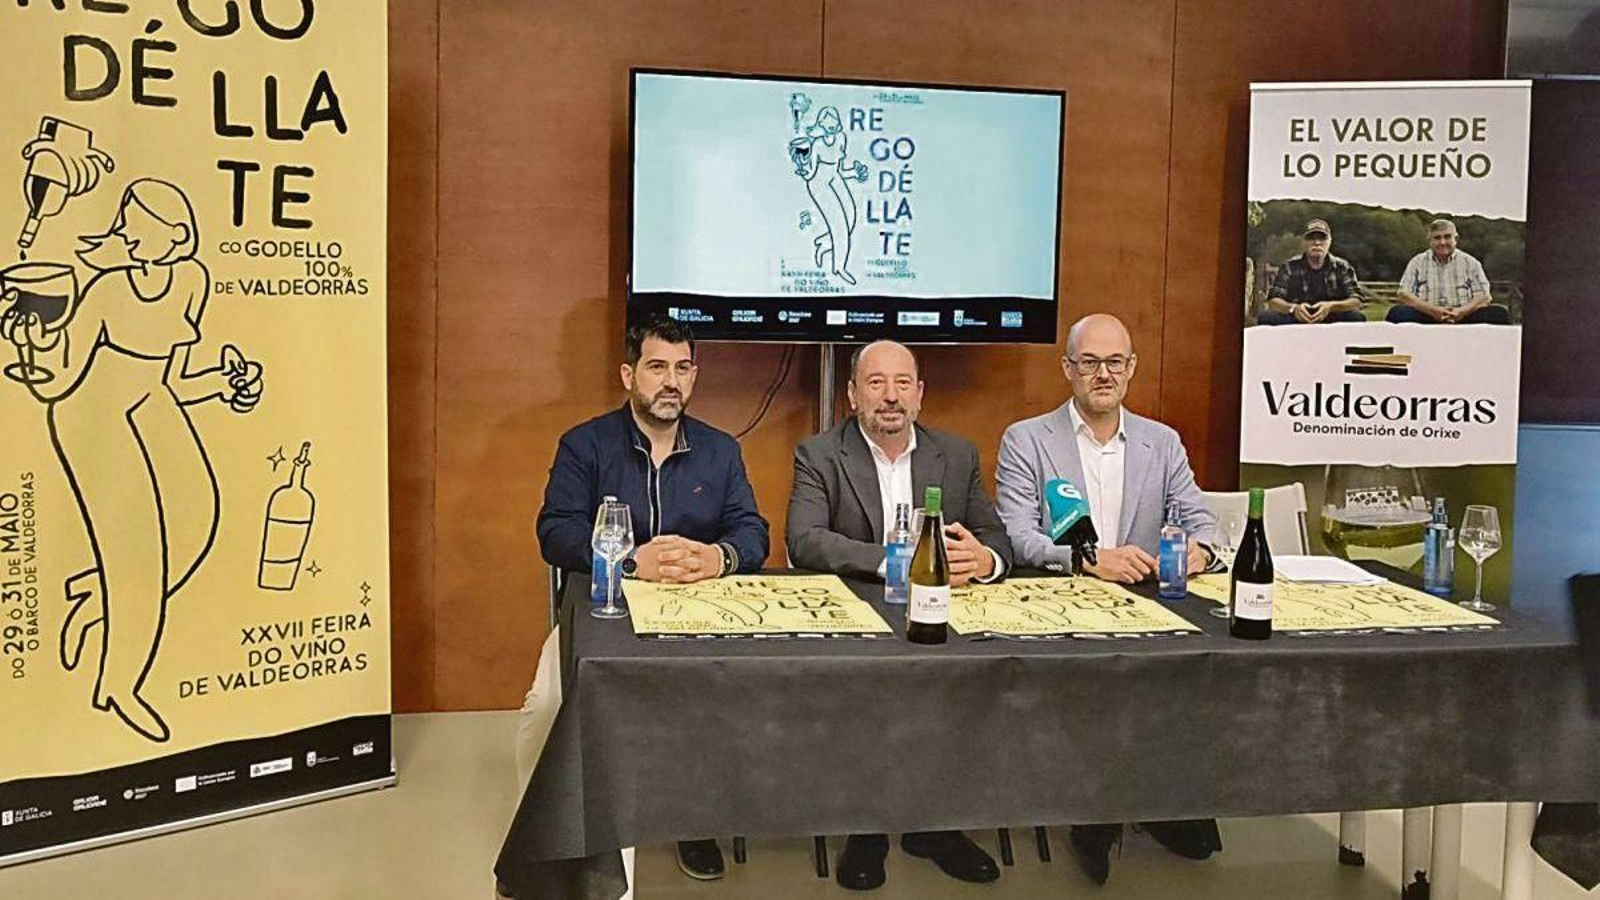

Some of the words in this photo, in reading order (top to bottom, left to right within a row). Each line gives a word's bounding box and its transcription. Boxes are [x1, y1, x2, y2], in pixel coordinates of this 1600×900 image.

[63, 19, 177, 107] DÉ
[213, 71, 347, 140] LLA
[850, 107, 884, 132] RE
[1290, 118, 1320, 142] EL
[1332, 117, 1433, 142] VALOR
[1449, 117, 1487, 142] DE
[869, 137, 916, 162] GO
[1284, 153, 1321, 178] LO
[1335, 148, 1491, 179] PEQUEÑO
[879, 164, 913, 193] DÉ
[217, 160, 314, 228] TE
[866, 197, 913, 224] LLA
[219, 242, 242, 254] CO
[245, 240, 342, 258] GODELLO
[879, 231, 912, 256] TE
[305, 260, 353, 278] 100%
[215, 281, 234, 294] DE
[238, 279, 369, 296] VALDEORRAS
[1262, 381, 1496, 424] Valdeorras
[1293, 422, 1395, 436] Denominación
[1400, 426, 1418, 437] de
[1422, 427, 1461, 439] Orixe
[0, 493, 20, 552] MAIO
[20, 471, 37, 563] VALDEORRAS
[8, 558, 21, 576] DE
[24, 566, 37, 584] DE
[2, 581, 22, 603] 31
[25, 587, 39, 636] BARCO
[3, 625, 24, 655] 29
[241, 620, 304, 646] XXVII
[311, 612, 372, 635] FEIRA
[248, 647, 283, 668] DO
[290, 635, 346, 661] VIÑO
[11, 658, 25, 679] DO
[179, 677, 209, 699] DE
[217, 653, 368, 692] VALDEORRAS
